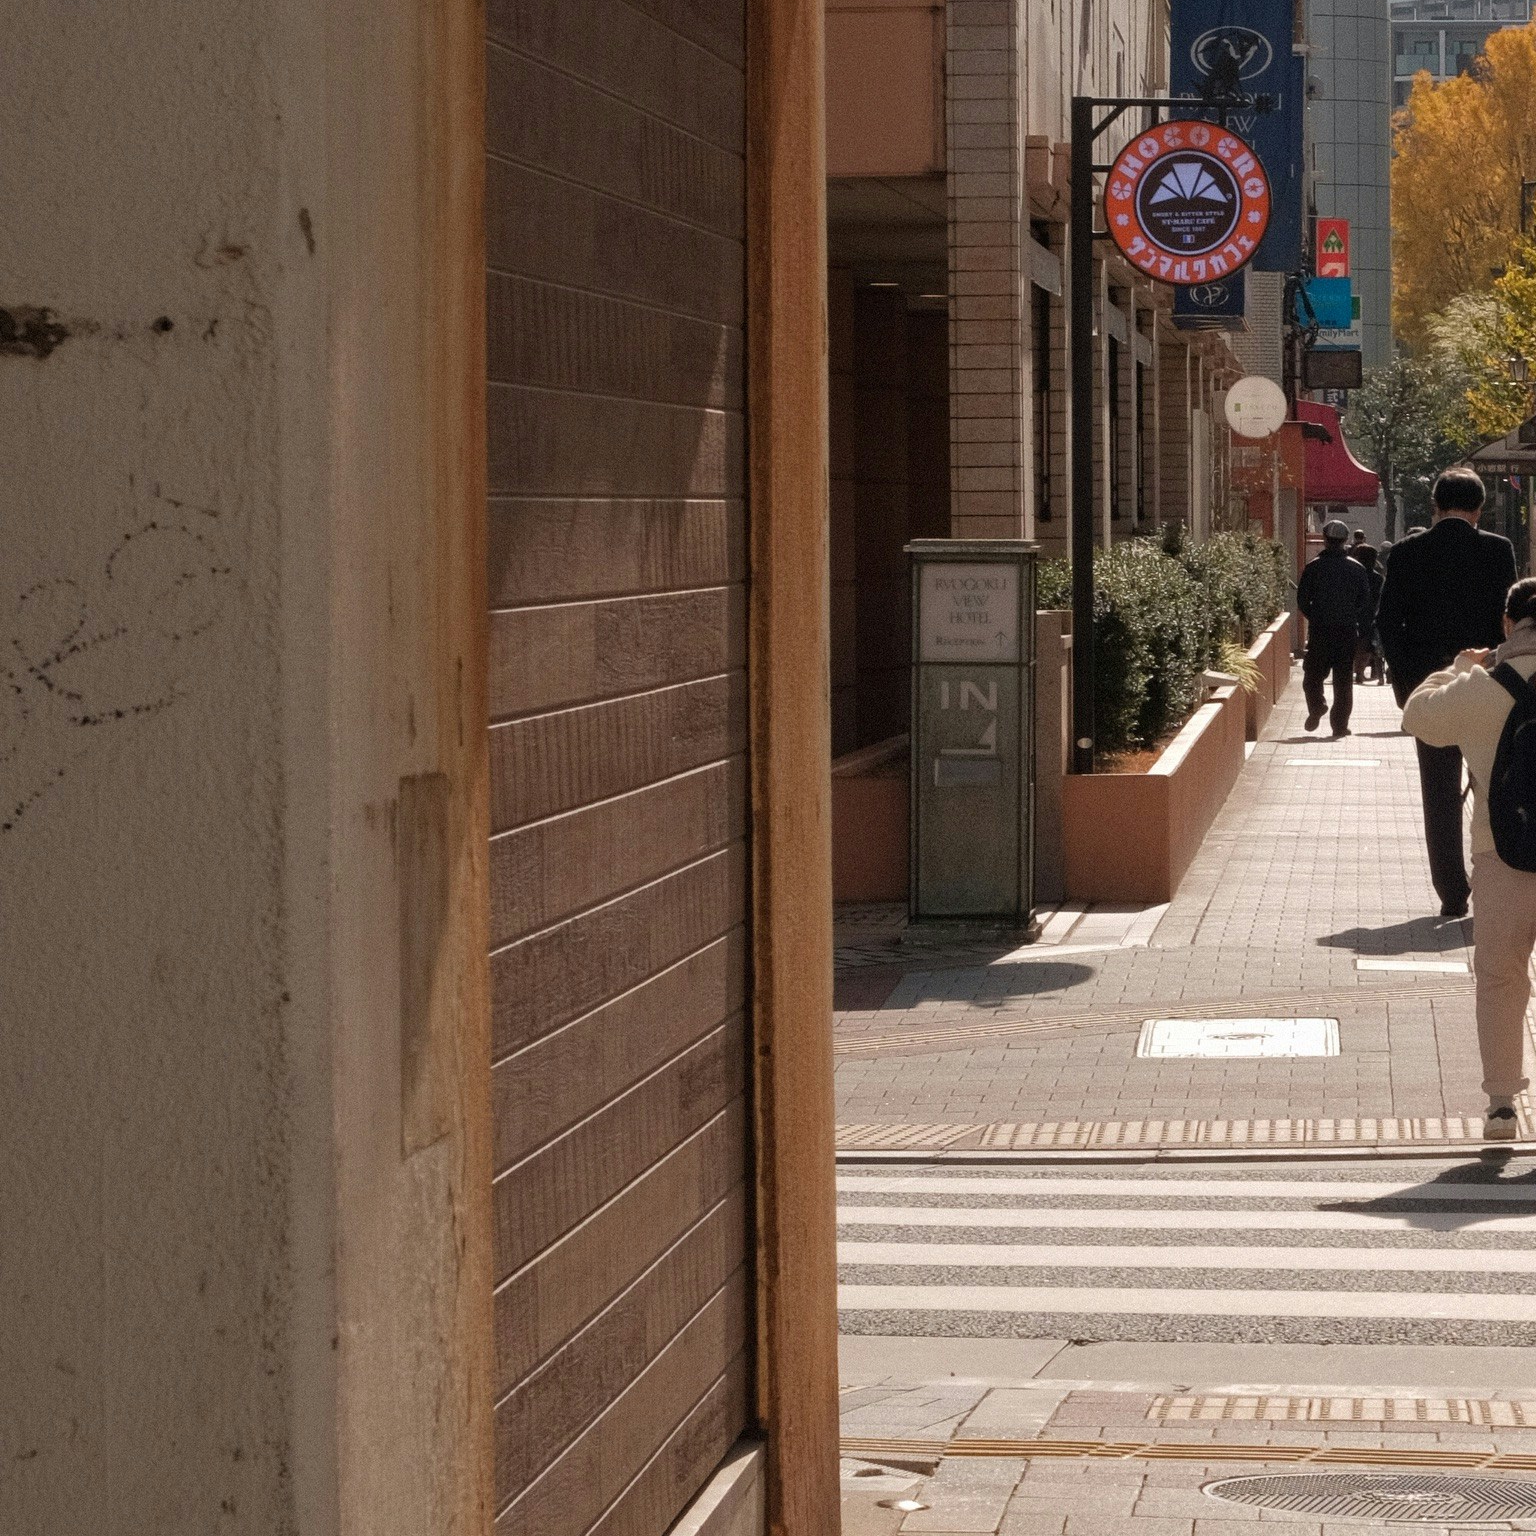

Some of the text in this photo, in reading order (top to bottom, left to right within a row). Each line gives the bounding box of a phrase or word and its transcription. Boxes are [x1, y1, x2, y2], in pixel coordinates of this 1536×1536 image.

[1111, 125, 1265, 201] CHOCO CRO
[1127, 234, 1255, 281] サンマルクカフェ
[940, 681, 998, 711] IN
